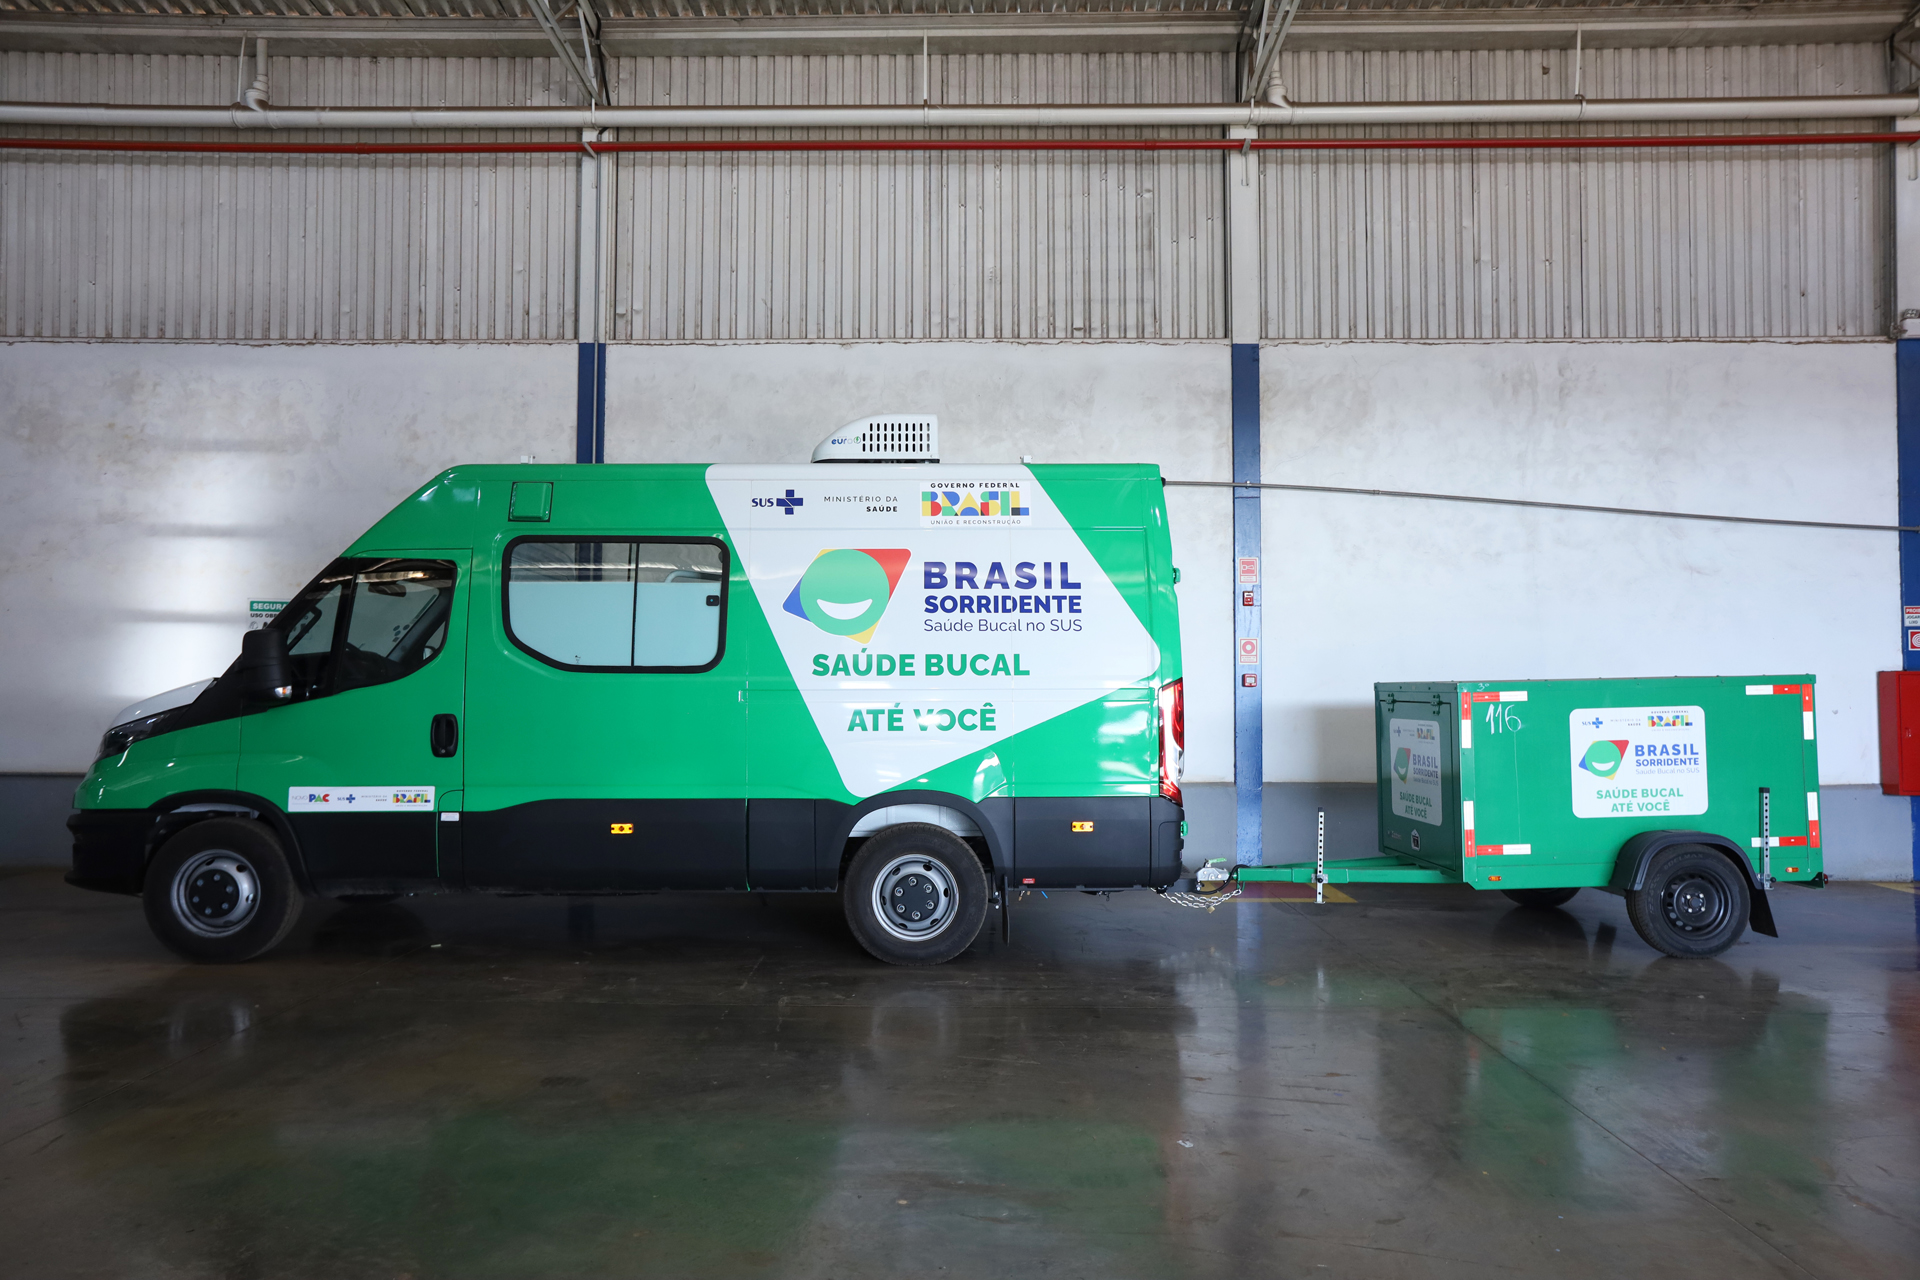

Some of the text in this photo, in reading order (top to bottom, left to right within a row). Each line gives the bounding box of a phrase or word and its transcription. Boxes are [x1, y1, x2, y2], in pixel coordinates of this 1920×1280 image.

[751, 497, 774, 507] SUS
[921, 491, 1030, 516] BRASIL
[923, 561, 1082, 590] BRASIL
[924, 595, 1082, 614] SORRIDENTE
[923, 618, 1083, 632] Saúde Bucal no SUS
[811, 647, 1030, 676] SAÚDE BUCAL
[847, 702, 997, 732] ATÉ VOCÊ
[1485, 703, 1522, 735] 116
[1647, 715, 1693, 727] BRASIL
[1634, 743, 1699, 757] BRASIL
[1412, 754, 1438, 768] BRASIL
[1635, 757, 1700, 767] SORRIDENTE
[1635, 767, 1656, 775] Saúde
[1657, 767, 1676, 775] Bucal
[1686, 766, 1700, 774] SUS
[308, 793, 330, 803] PAC
[392, 793, 431, 803] BRASIL
[1399, 790, 1432, 807] SAÚDE BUCAL
[1596, 787, 1684, 800] SAÚDE BUCAL
[1405, 804, 1427, 819] ATÉ VOCÊ
[1611, 799, 1670, 813] ATÉ VOCÊ
